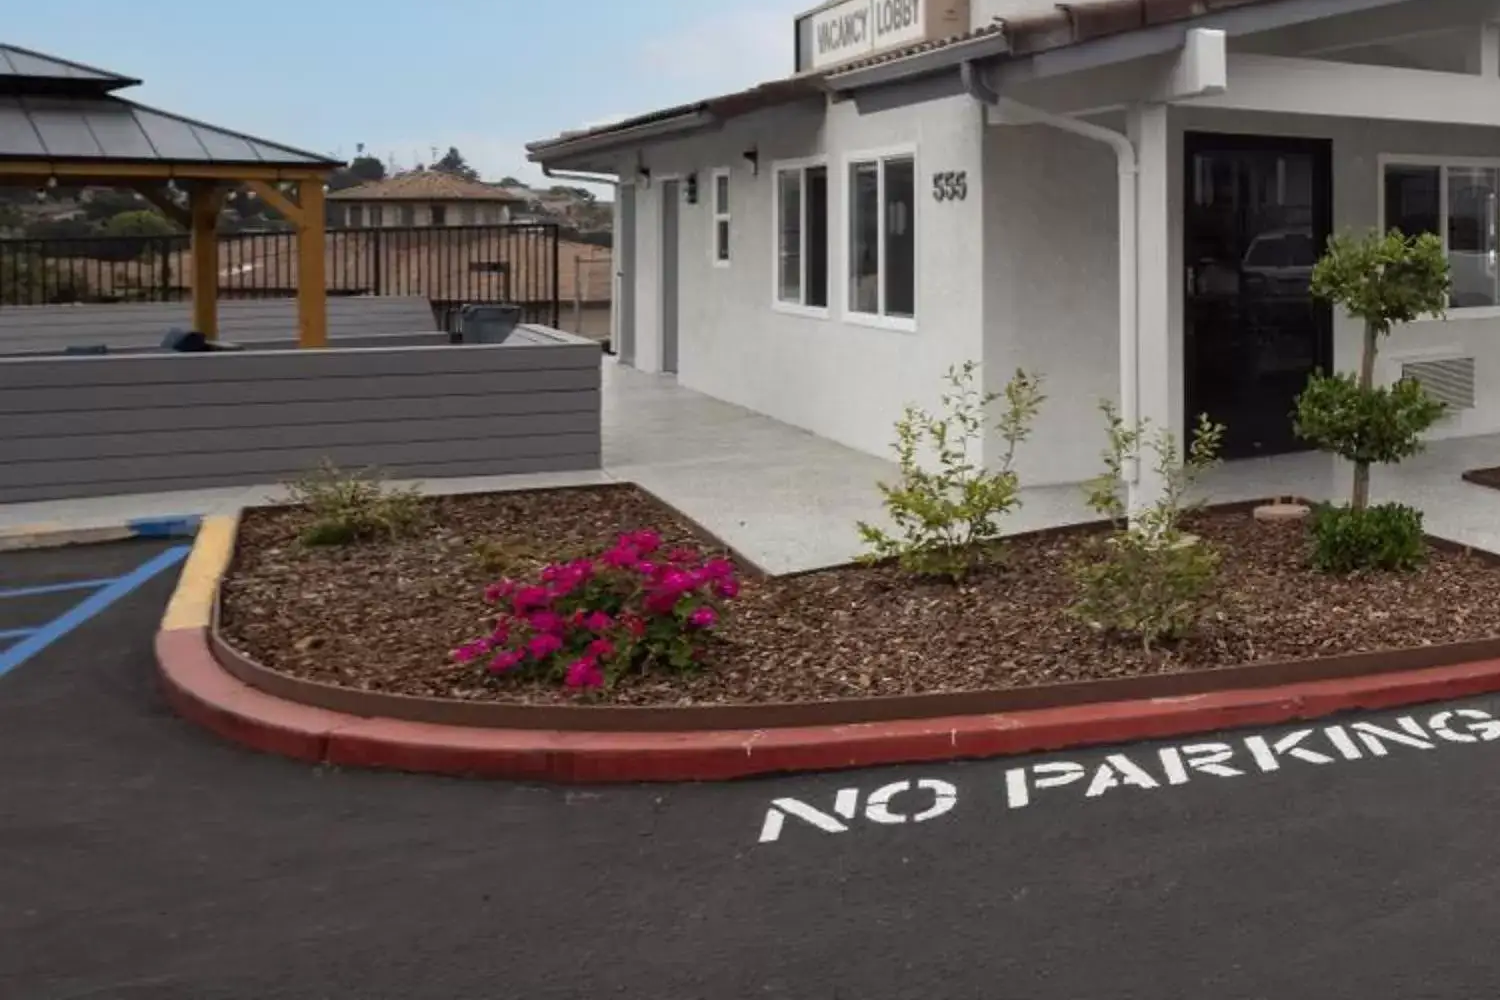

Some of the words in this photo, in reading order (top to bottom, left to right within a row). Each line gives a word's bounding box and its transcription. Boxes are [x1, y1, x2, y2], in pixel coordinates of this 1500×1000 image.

[817, 7, 868, 54] VACANCY
[932, 171, 967, 203] 555
[760, 780, 957, 843] NO
